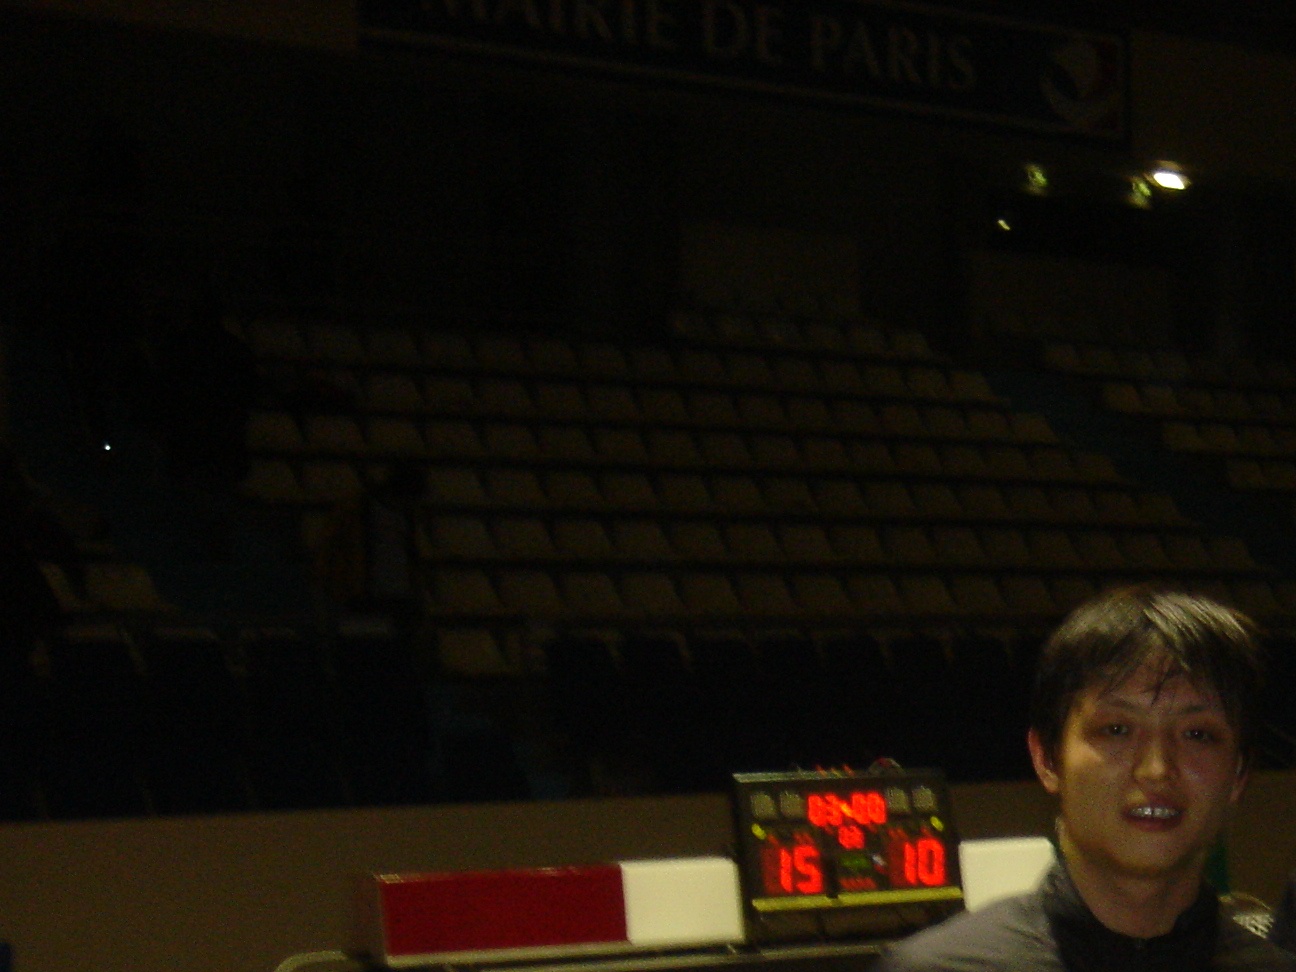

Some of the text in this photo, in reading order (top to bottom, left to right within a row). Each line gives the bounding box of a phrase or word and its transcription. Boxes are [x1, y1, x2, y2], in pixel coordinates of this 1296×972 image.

[418, 0, 978, 92] IRIE DE PARIS
[779, 844, 824, 895] 15
[904, 838, 946, 887] 10
